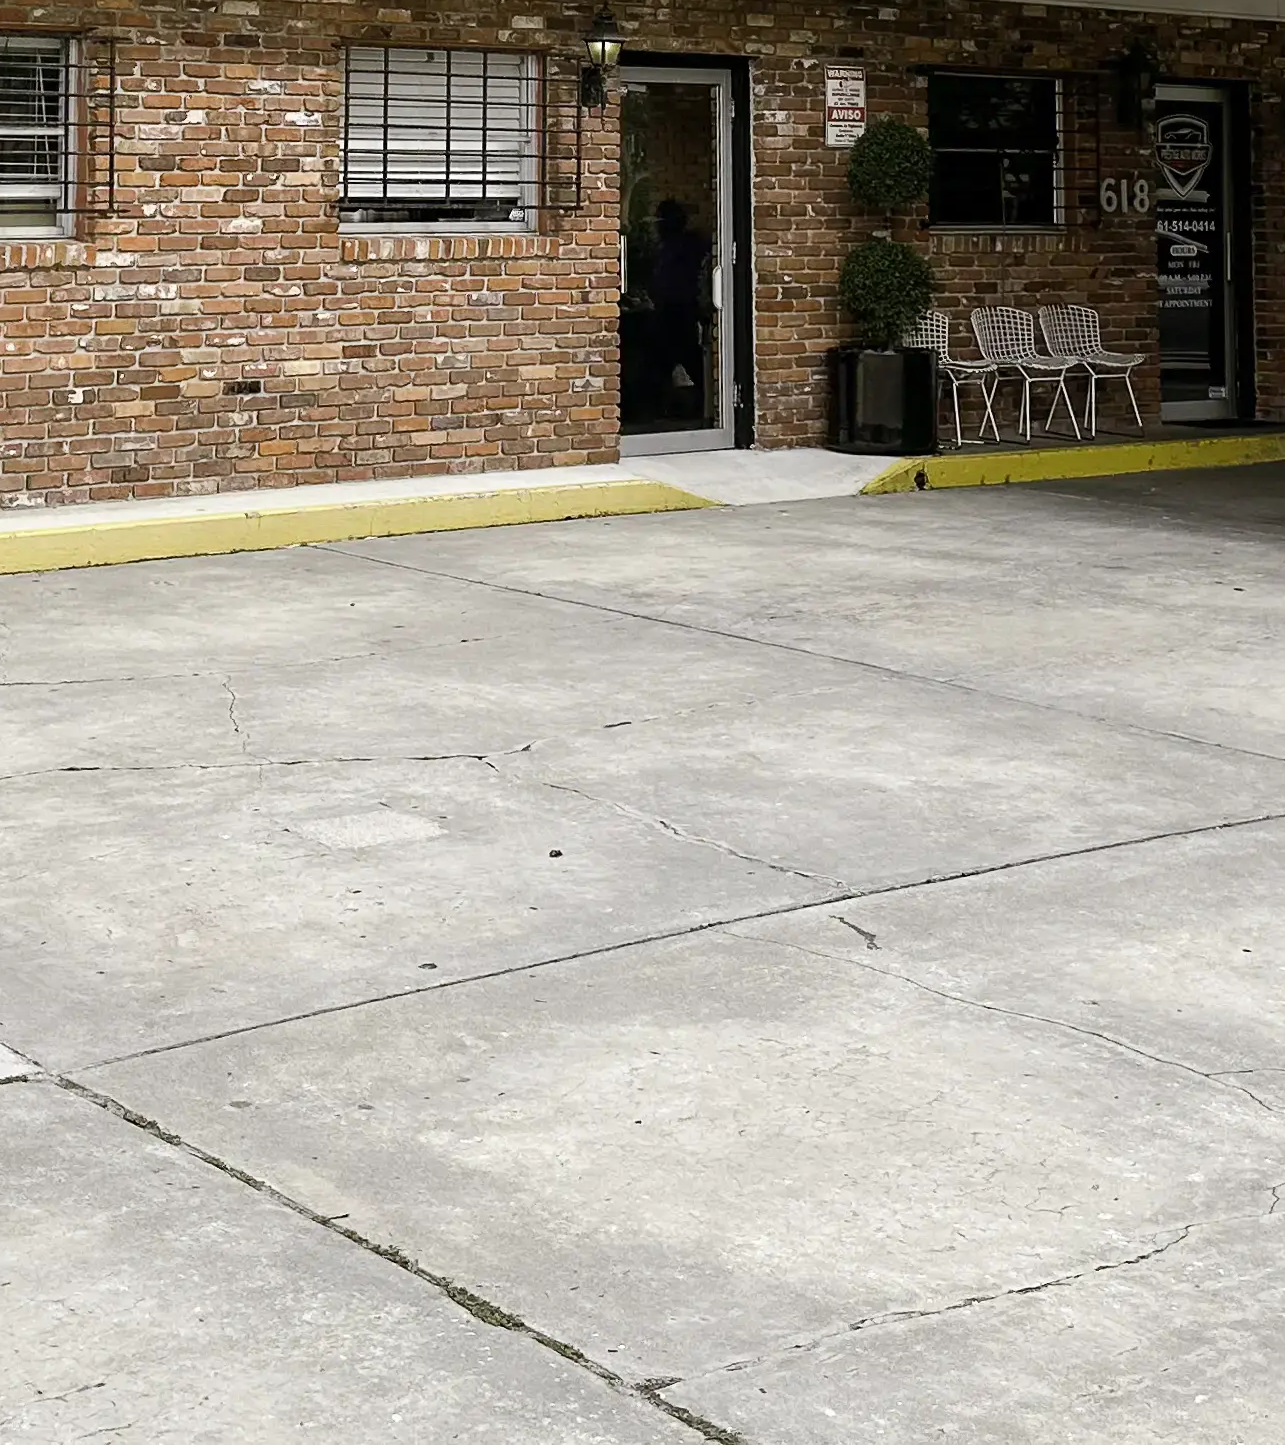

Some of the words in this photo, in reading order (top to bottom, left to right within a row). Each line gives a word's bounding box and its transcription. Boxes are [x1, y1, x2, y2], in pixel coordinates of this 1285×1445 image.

[831, 109, 862, 120] AVISO
[1100, 177, 1150, 213] 618
[1157, 220, 1215, 232] 61-514-0414
[1164, 299, 1213, 308] APPOINTMENT
